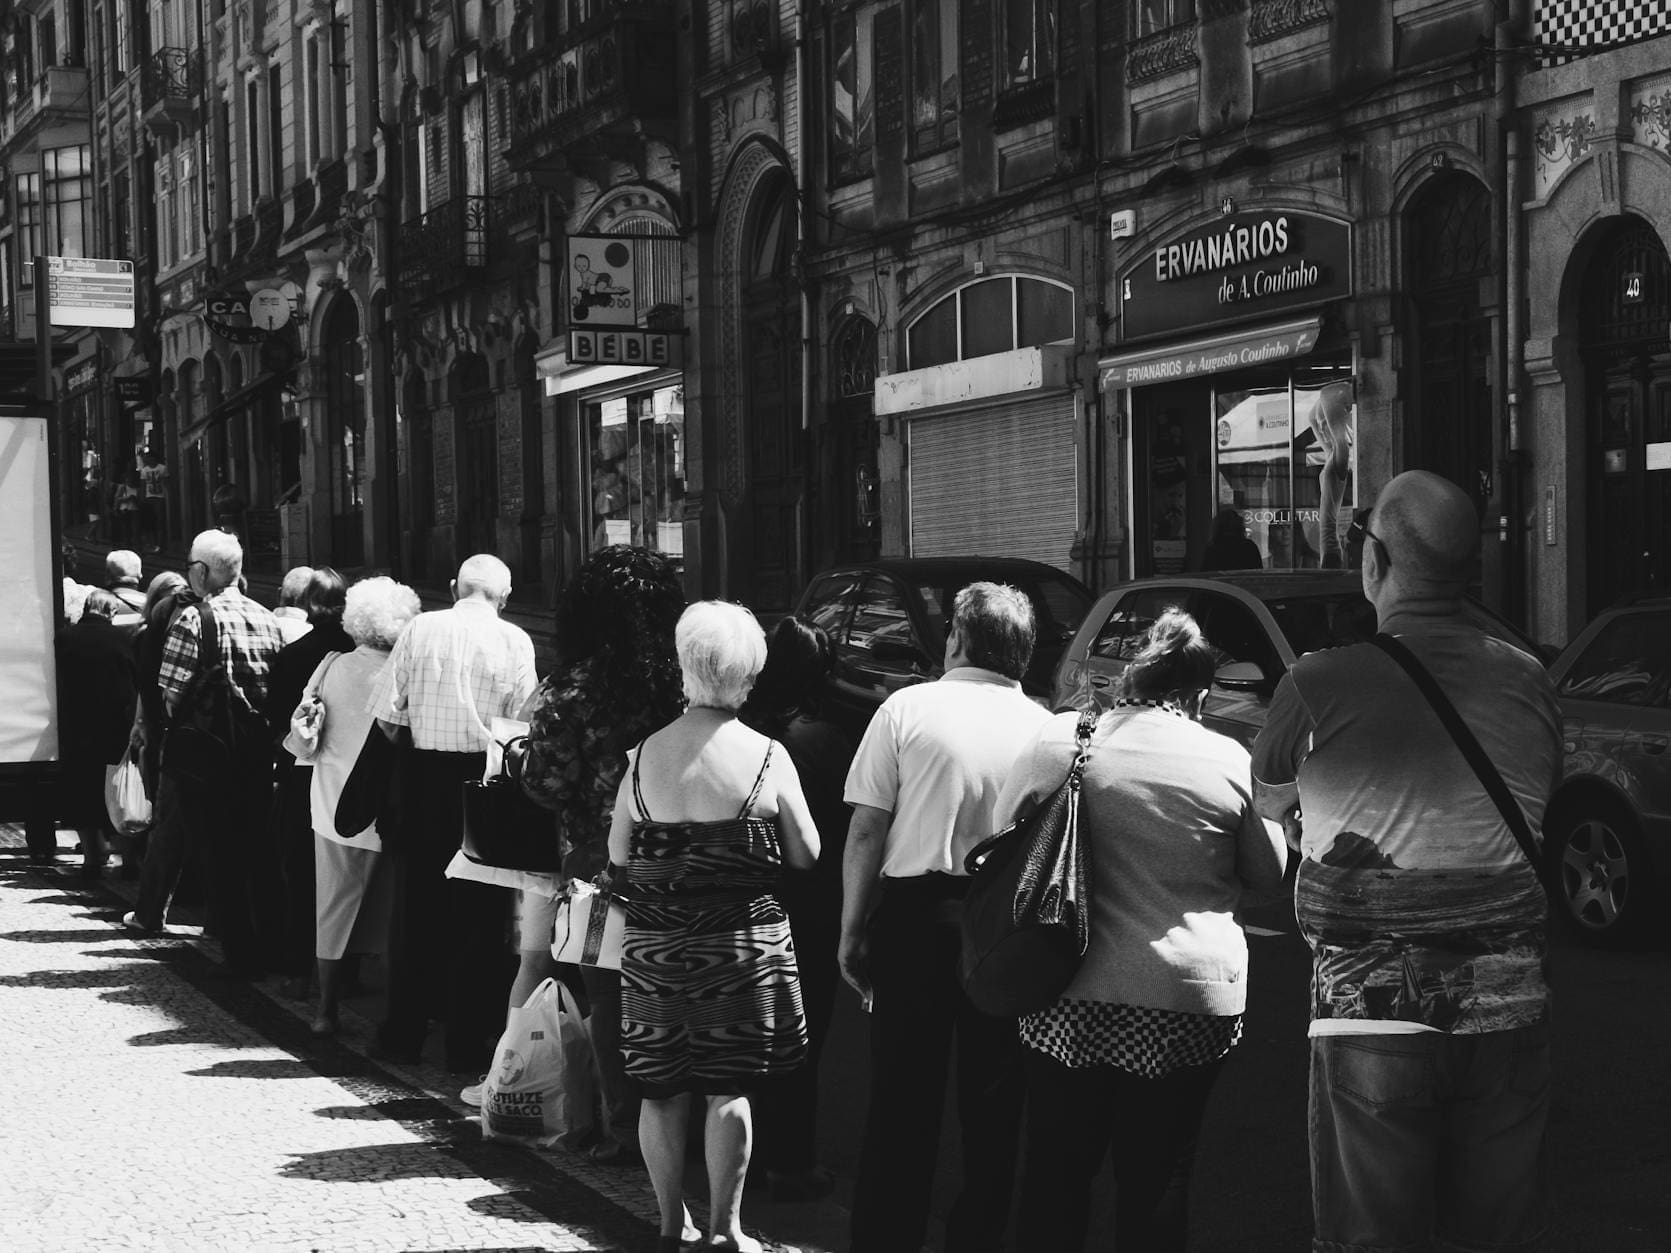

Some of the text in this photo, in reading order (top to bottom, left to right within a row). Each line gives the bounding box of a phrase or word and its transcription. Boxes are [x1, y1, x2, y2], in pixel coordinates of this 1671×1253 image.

[1156, 217, 1288, 282] ERVANÁRIOS
[1219, 260, 1318, 304] de A. Coutinho
[1626, 278, 1640, 298] 40
[1127, 341, 1289, 383] ERVANARIOS de Augusto Coutinho
[1254, 510, 1320, 522] COLLITAR
[505, 1105, 543, 1116] SACO
